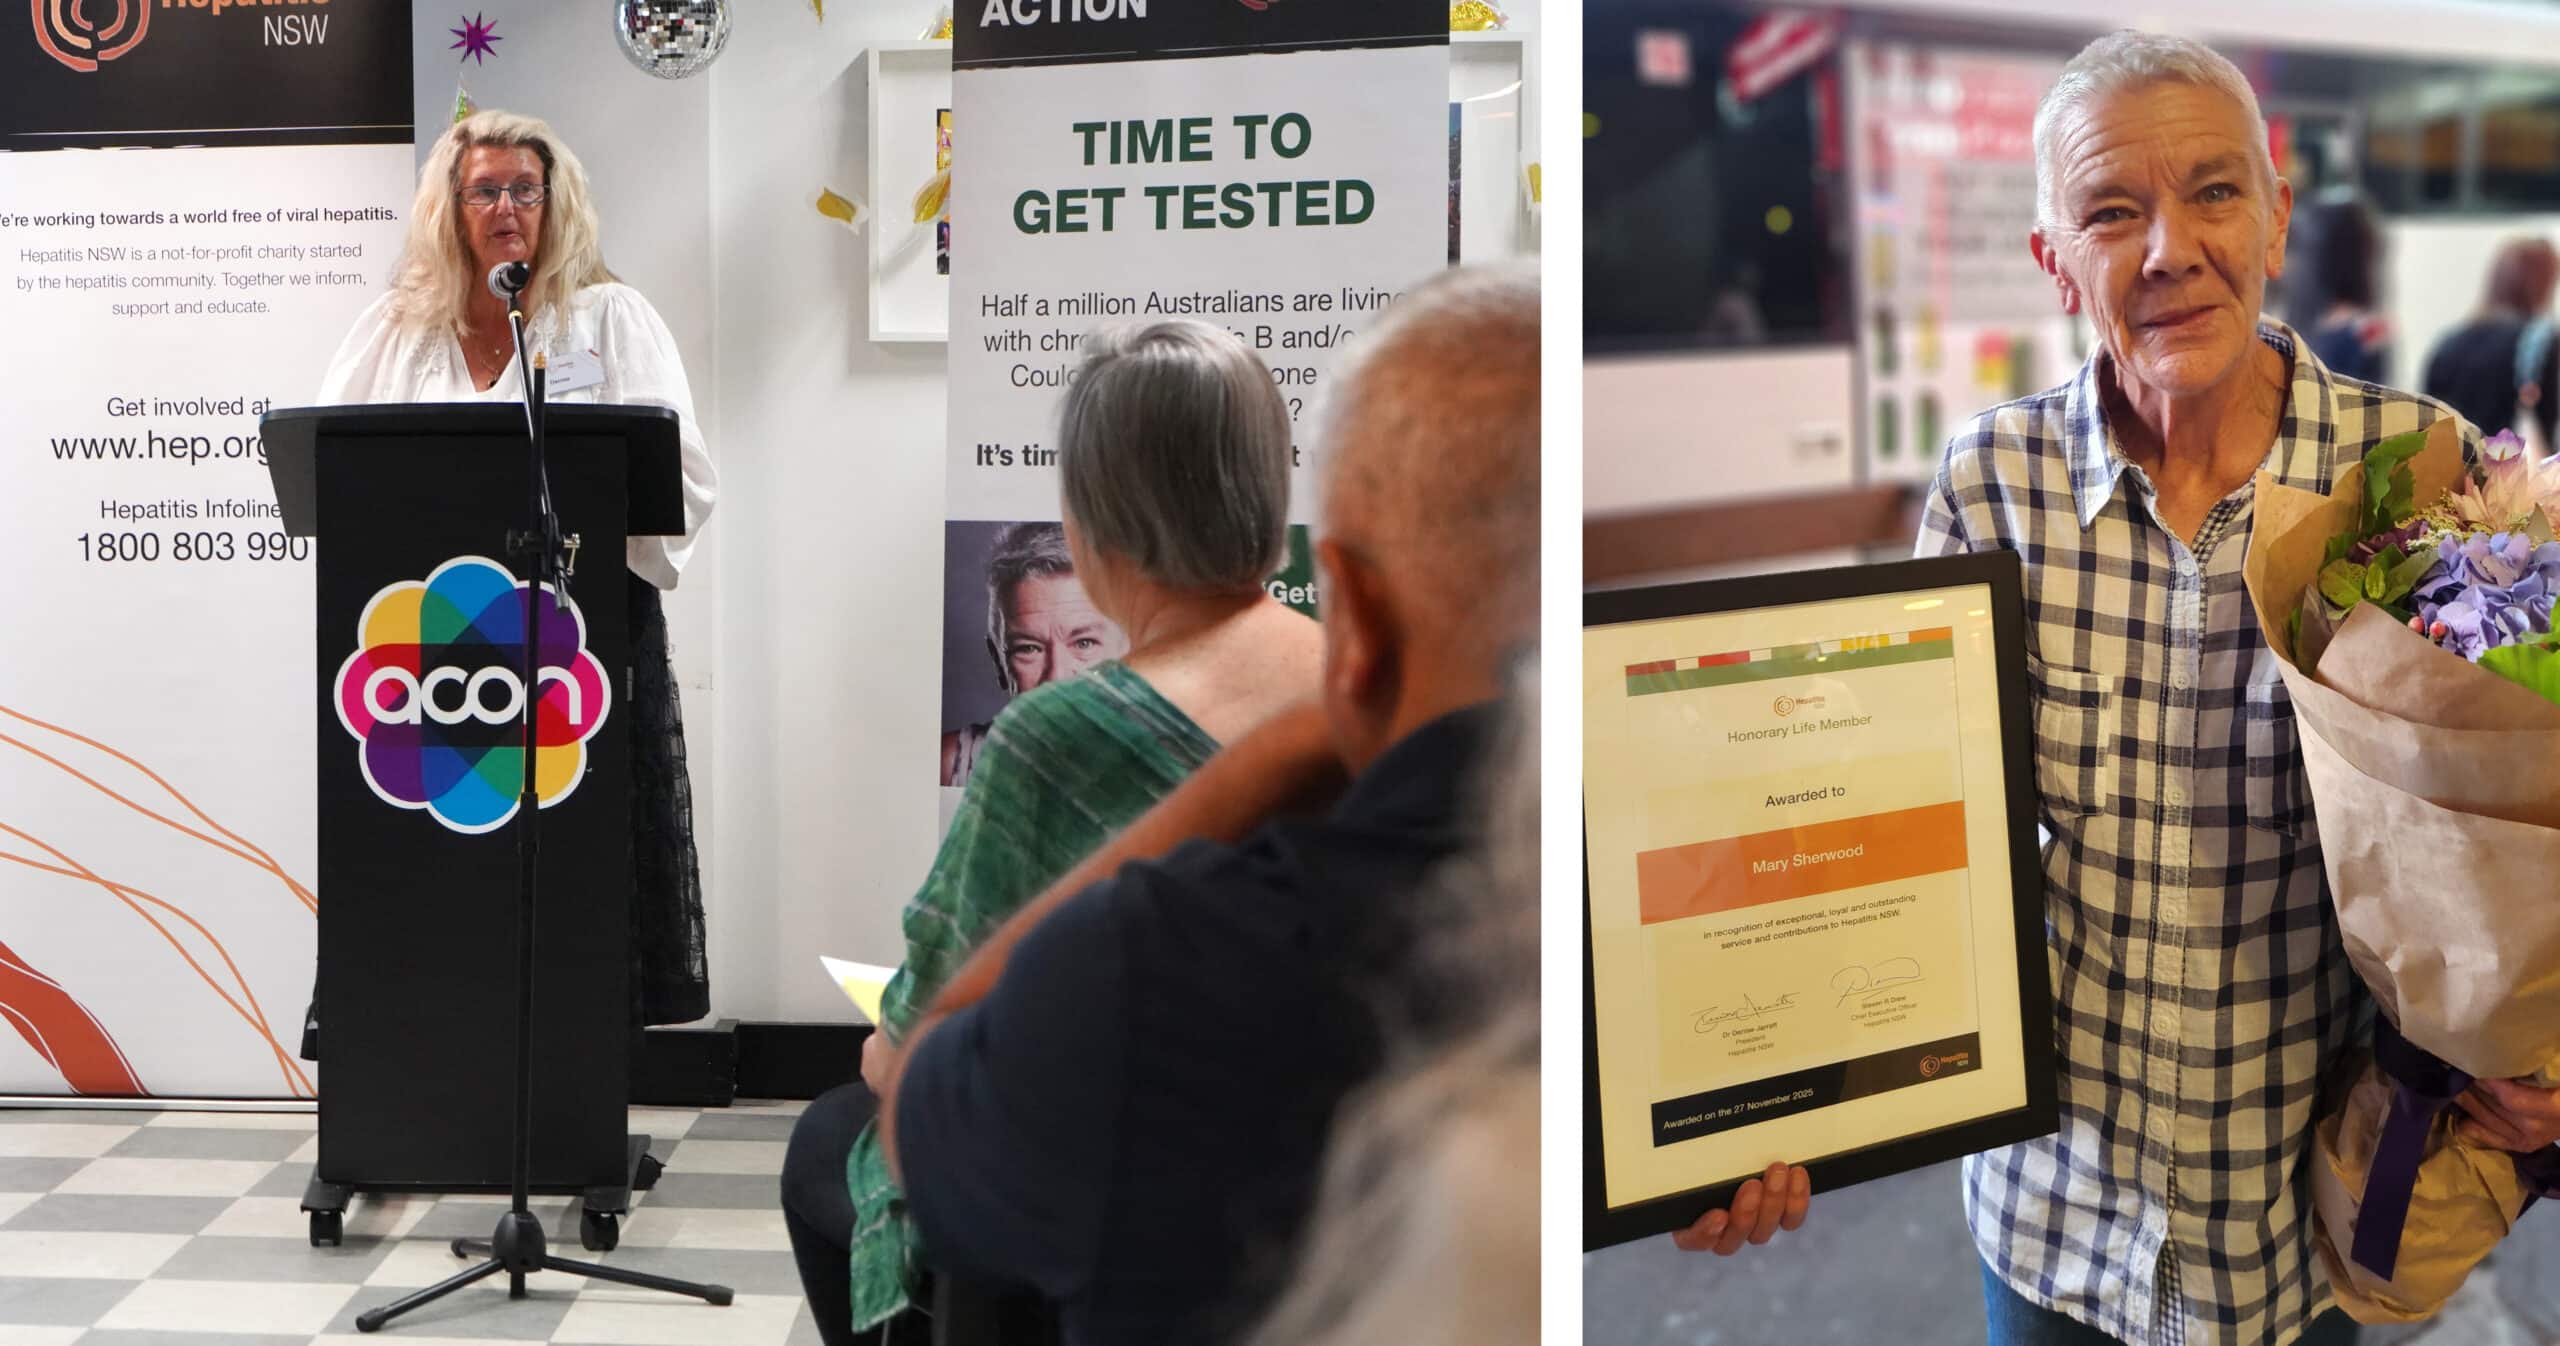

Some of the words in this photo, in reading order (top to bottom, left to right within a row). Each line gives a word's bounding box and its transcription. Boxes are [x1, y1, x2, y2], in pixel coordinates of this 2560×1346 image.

[264, 14, 329, 46] NSW
[1072, 116, 1214, 166] TIME
[1233, 112, 1312, 160] TO
[0, 212, 29, 227] e're
[34, 212, 95, 229] working
[100, 211, 164, 225] towards
[169, 213, 179, 224] a
[184, 210, 227, 224] world
[232, 209, 262, 223] free
[266, 209, 282, 222] of
[286, 208, 318, 222] viral
[324, 206, 398, 224] hepatitis.
[1013, 187, 1126, 235] GET
[1144, 179, 1376, 231] TESTED
[20, 248, 83, 264] Hepatitis
[88, 247, 126, 261] NSW
[131, 248, 143, 261] is
[147, 250, 157, 260] a
[161, 245, 252, 262] not-for-profit
[257, 245, 305, 261] charity
[310, 244, 362, 258] started
[17, 276, 34, 292] by
[38, 275, 61, 289] the
[65, 274, 127, 291] hepatitis
[132, 273, 217, 290] community.
[222, 272, 285, 289] Together
[289, 274, 311, 286] we
[315, 271, 367, 286] inform,
[112, 301, 169, 318] support
[174, 300, 202, 314] and
[207, 300, 270, 314] educate.
[981, 293, 1029, 317] Half
[1035, 298, 1050, 316] a
[1058, 292, 1136, 316] million
[1144, 289, 1285, 315] Australians
[1293, 293, 1333, 312] are
[984, 329, 1032, 352] with
[1255, 325, 1273, 349] B
[107, 397, 146, 417] Get
[154, 396, 244, 416] involved
[251, 396, 272, 416] at
[976, 443, 1014, 466] It's
[101, 500, 198, 523] Hepatitis
[206, 499, 283, 519] Infoline
[77, 532, 160, 562] 1800
[173, 531, 236, 562] 803
[247, 531, 310, 562] 990
[363, 666, 582, 726] acon
[1727, 726, 1789, 744] Honorary
[1793, 721, 1816, 735] Life
[1820, 714, 1873, 731] Member
[1764, 787, 1828, 808] Awarded
[1832, 786, 1846, 797] to
[1752, 859, 1789, 874] Mary
[1793, 843, 1864, 867] Sherwood
[1703, 931, 1712, 939] in
[1714, 922, 1763, 937] recognition
[1764, 920, 1774, 928] of
[1829, 906, 1848, 917] loyal
[1850, 902, 1866, 912] and
[1868, 894, 1917, 909] outstanding
[1721, 938, 1753, 950] service
[1754, 933, 1771, 944] and
[1773, 923, 1829, 940] contributions
[1830, 921, 1840, 929] to
[1841, 913, 1878, 928] Hepatitis
[1663, 1112, 1703, 1130] Awarded
[1704, 1111, 1716, 1121] on
[1718, 1107, 1733, 1118] the
[1733, 1103, 1744, 1115] 27
[1747, 1093, 1791, 1112] November
[1792, 1087, 1814, 1101] 2025
